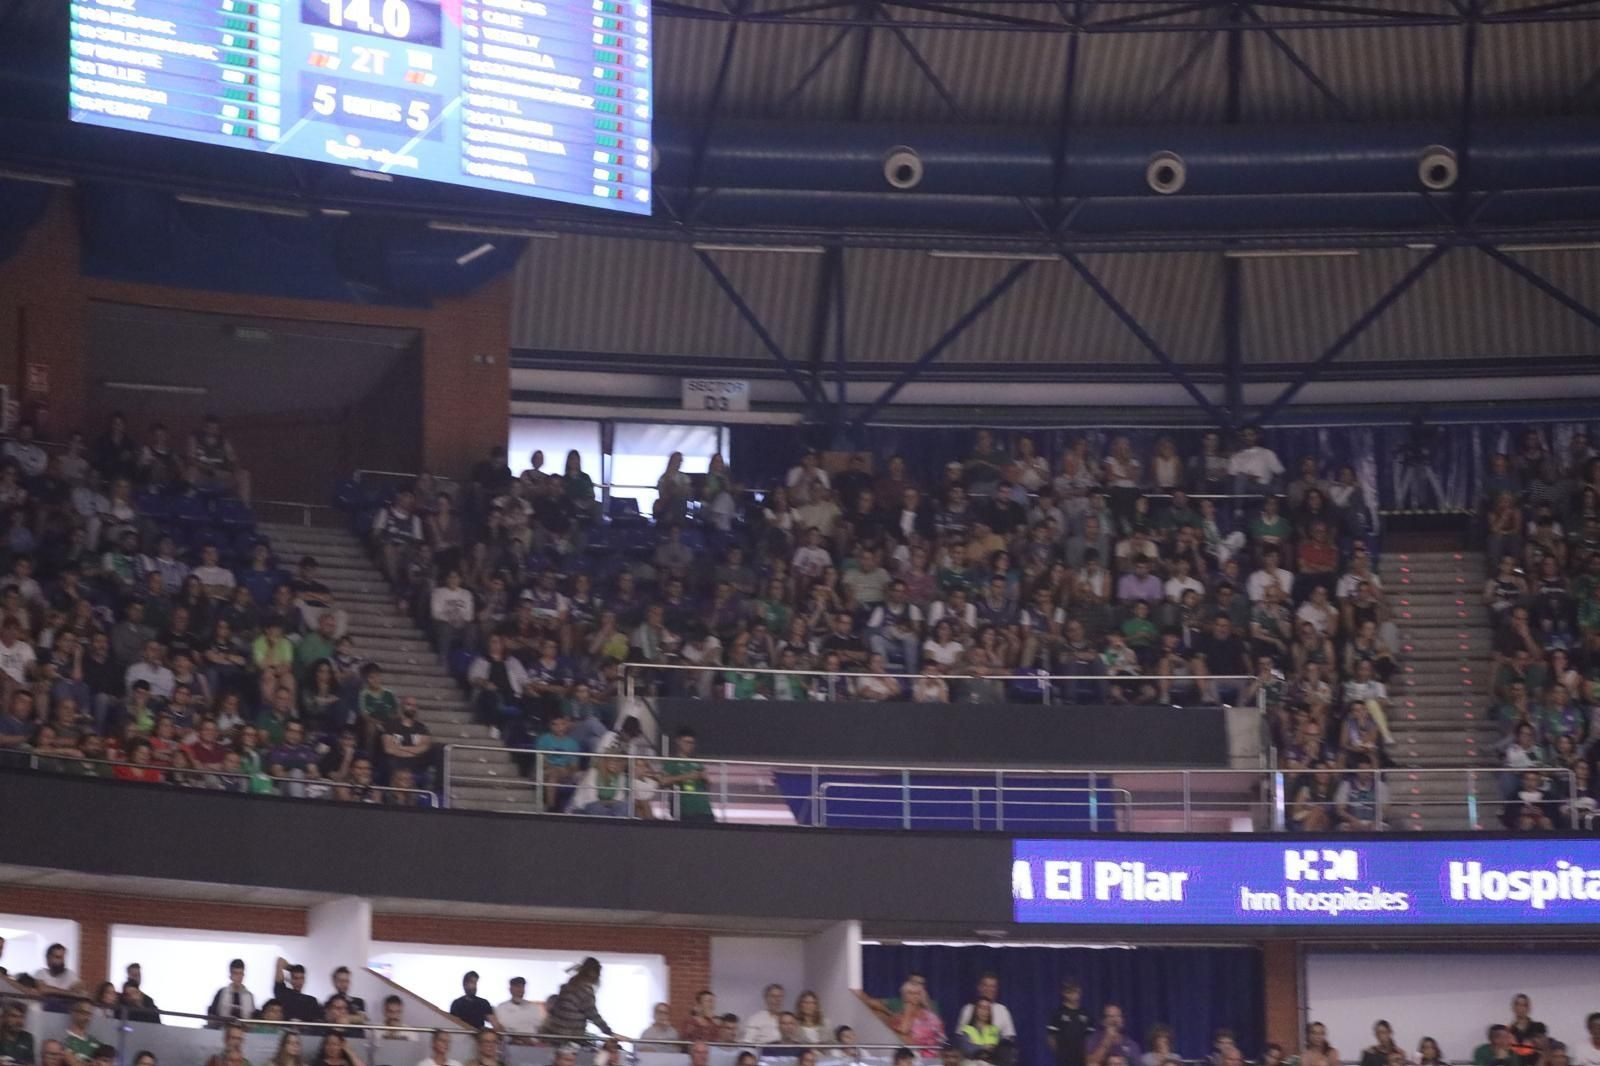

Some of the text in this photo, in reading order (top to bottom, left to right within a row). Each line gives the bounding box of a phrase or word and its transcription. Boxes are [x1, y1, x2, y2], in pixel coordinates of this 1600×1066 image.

[322, 0, 411, 37] 14.0
[351, 46, 389, 75] 2T
[312, 84, 337, 115] 5
[406, 101, 430, 131] 5
[1045, 860, 1083, 900] El
[1094, 861, 1188, 901] Pilar
[1241, 886, 1409, 916] hm hospitales
